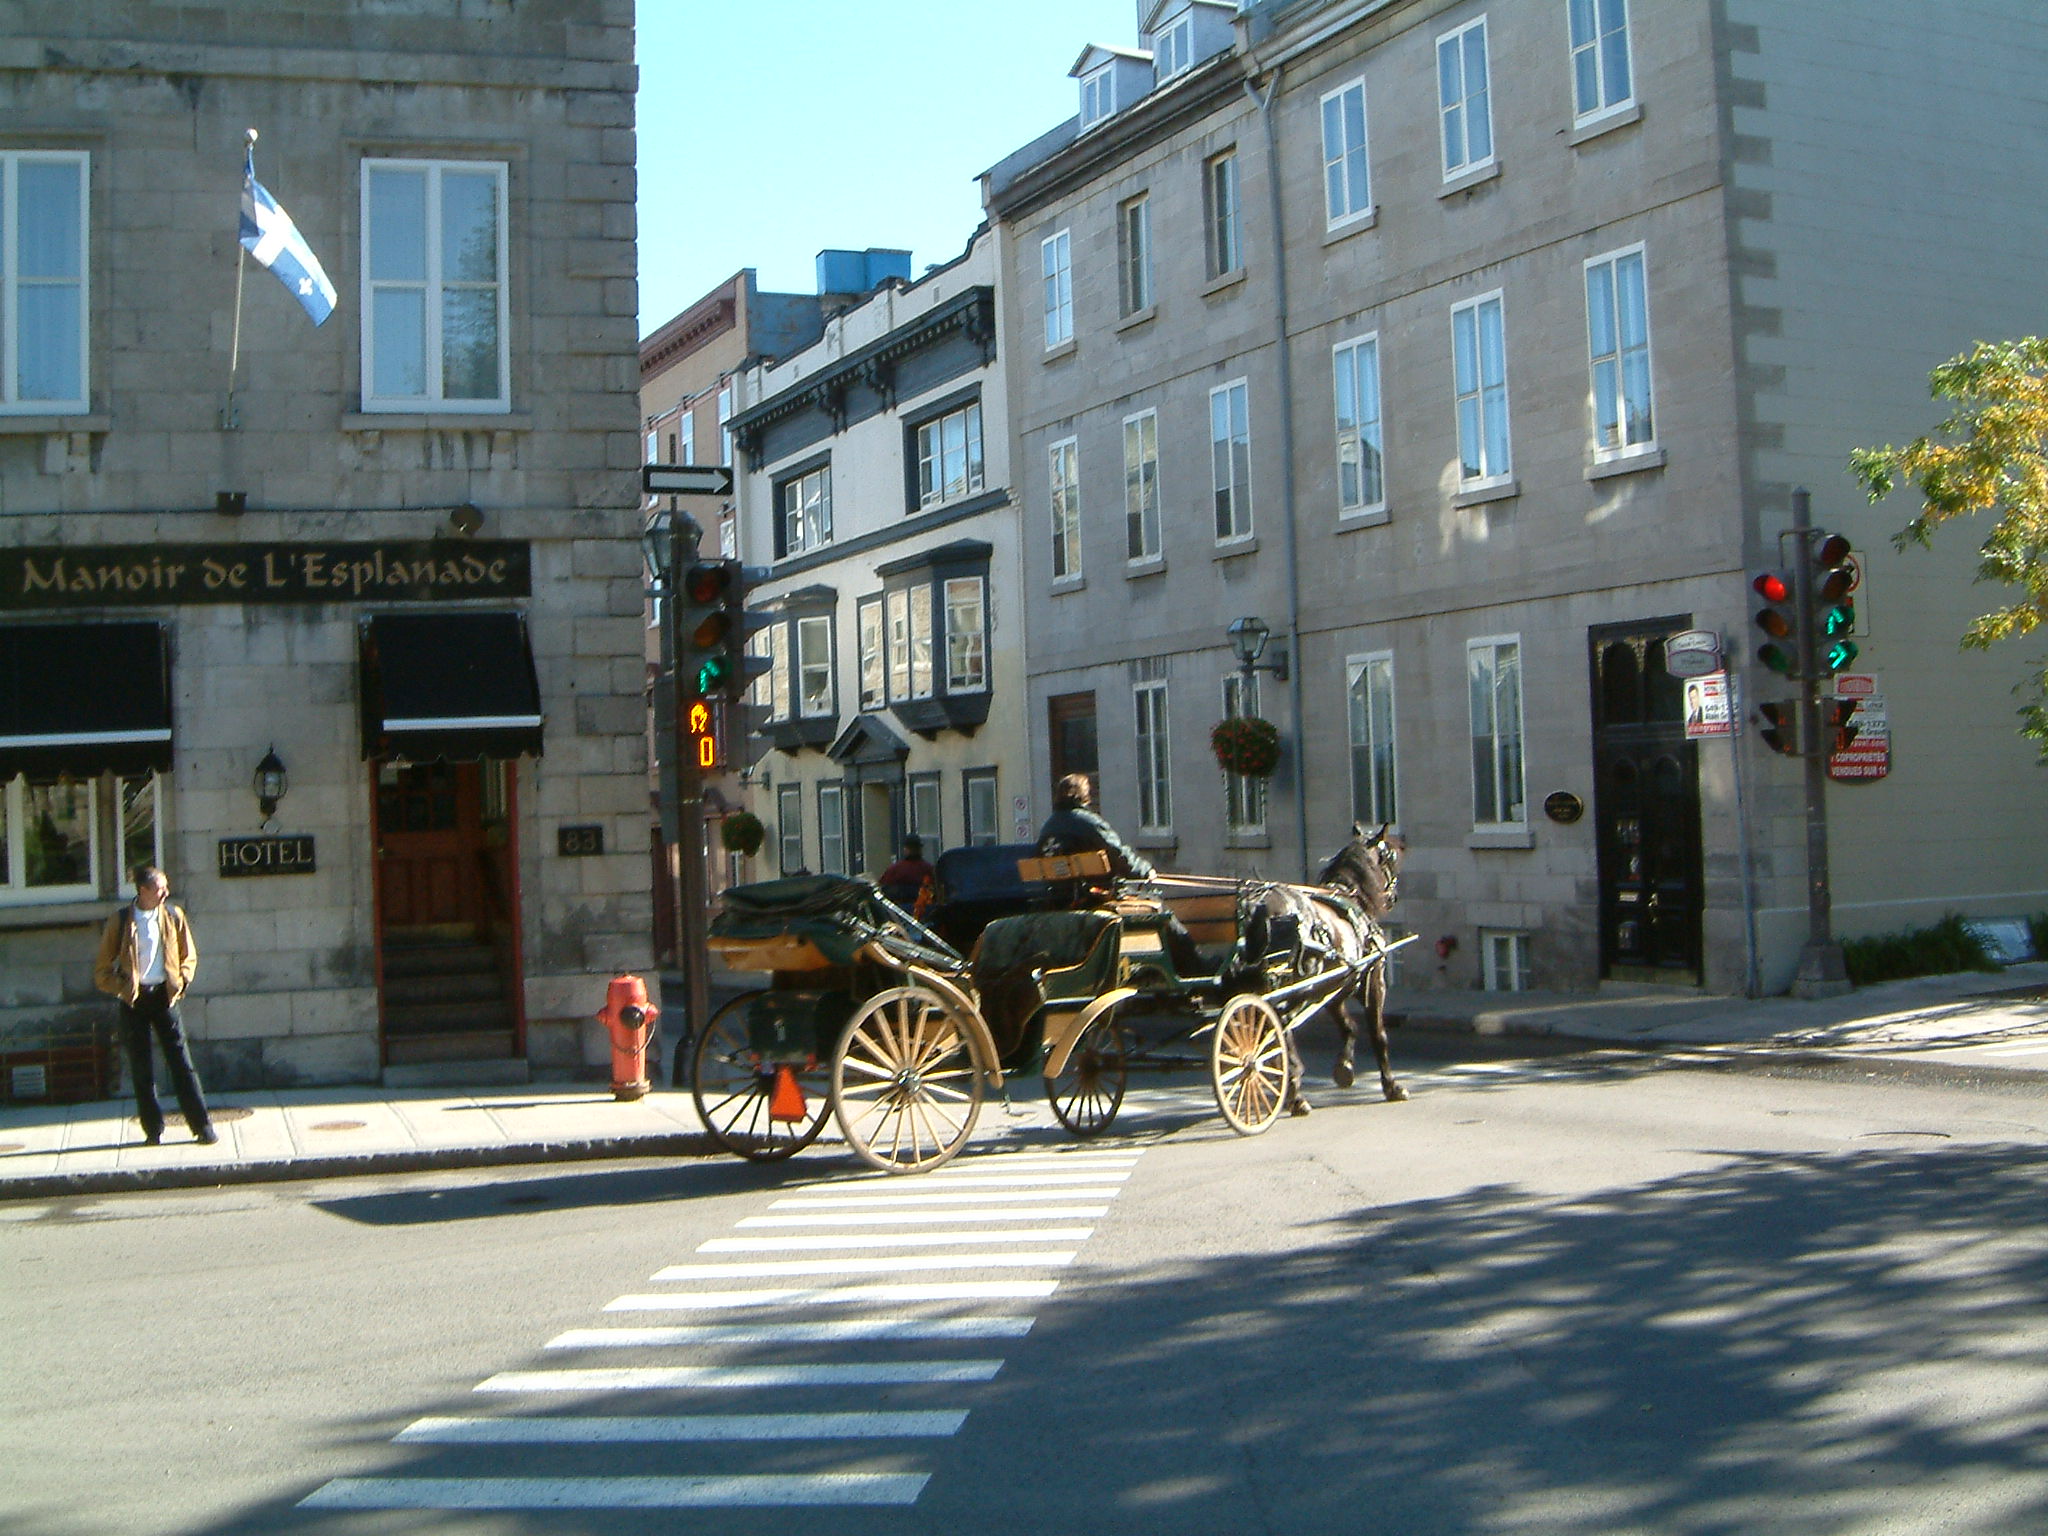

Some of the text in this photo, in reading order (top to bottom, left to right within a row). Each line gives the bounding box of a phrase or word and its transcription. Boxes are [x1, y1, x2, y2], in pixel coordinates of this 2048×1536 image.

[23, 549, 507, 596] Manoir de L'Esplanade
[700, 736, 714, 766] 0
[221, 840, 312, 867] HOTEL
